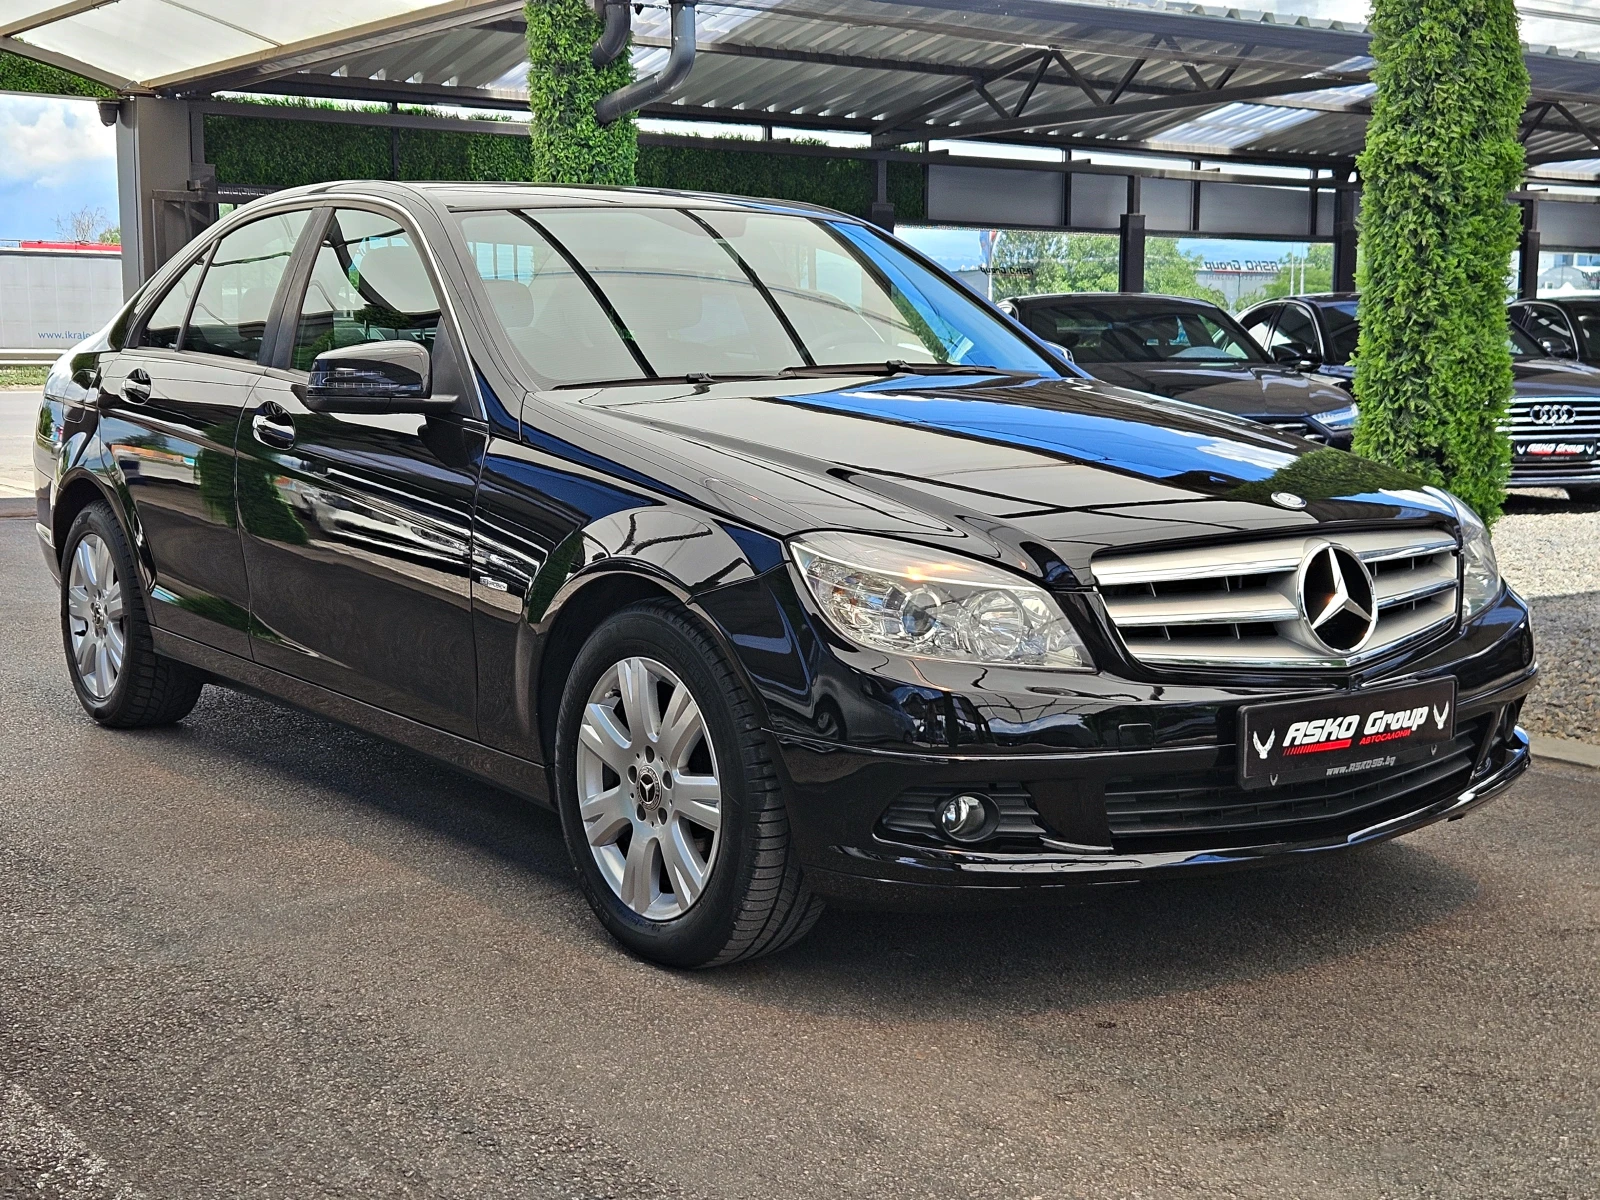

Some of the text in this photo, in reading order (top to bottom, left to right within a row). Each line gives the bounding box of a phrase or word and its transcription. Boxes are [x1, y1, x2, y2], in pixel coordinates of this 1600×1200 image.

[37, 330, 95, 340] www.ikrale
[1282, 706, 1429, 747] ASKO Group
[1359, 728, 1411, 745] АВТОСАЛОНИ
